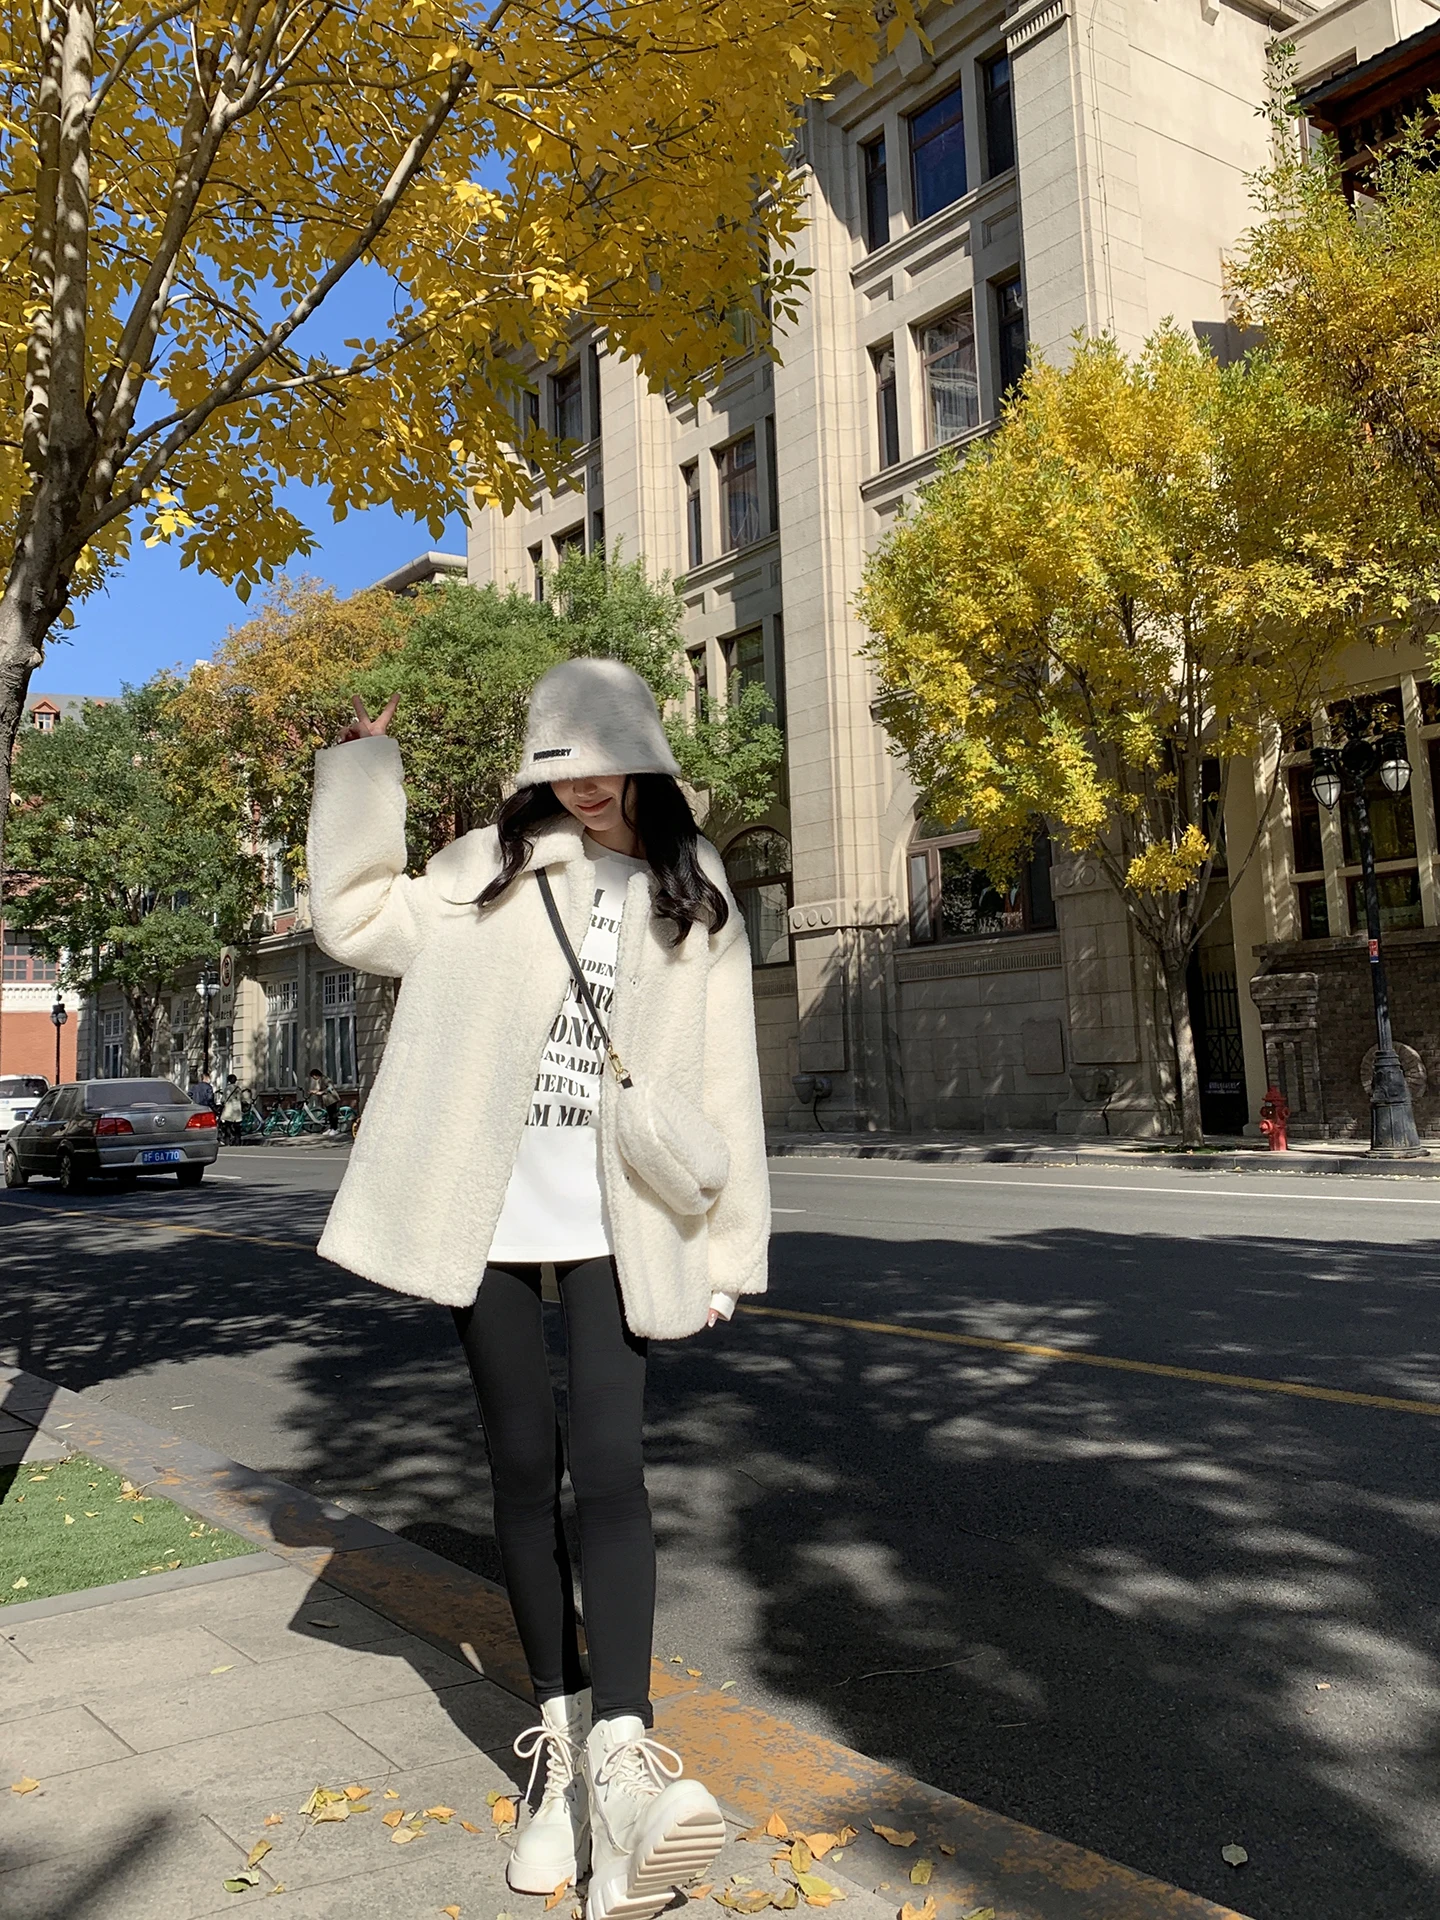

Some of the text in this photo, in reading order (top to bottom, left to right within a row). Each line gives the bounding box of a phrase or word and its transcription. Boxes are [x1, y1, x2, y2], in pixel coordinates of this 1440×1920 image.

[593, 888, 605, 908] I
[550, 1014, 602, 1051] ONG
[534, 1073, 590, 1098] TEFUL
[525, 1103, 592, 1127] M ME
